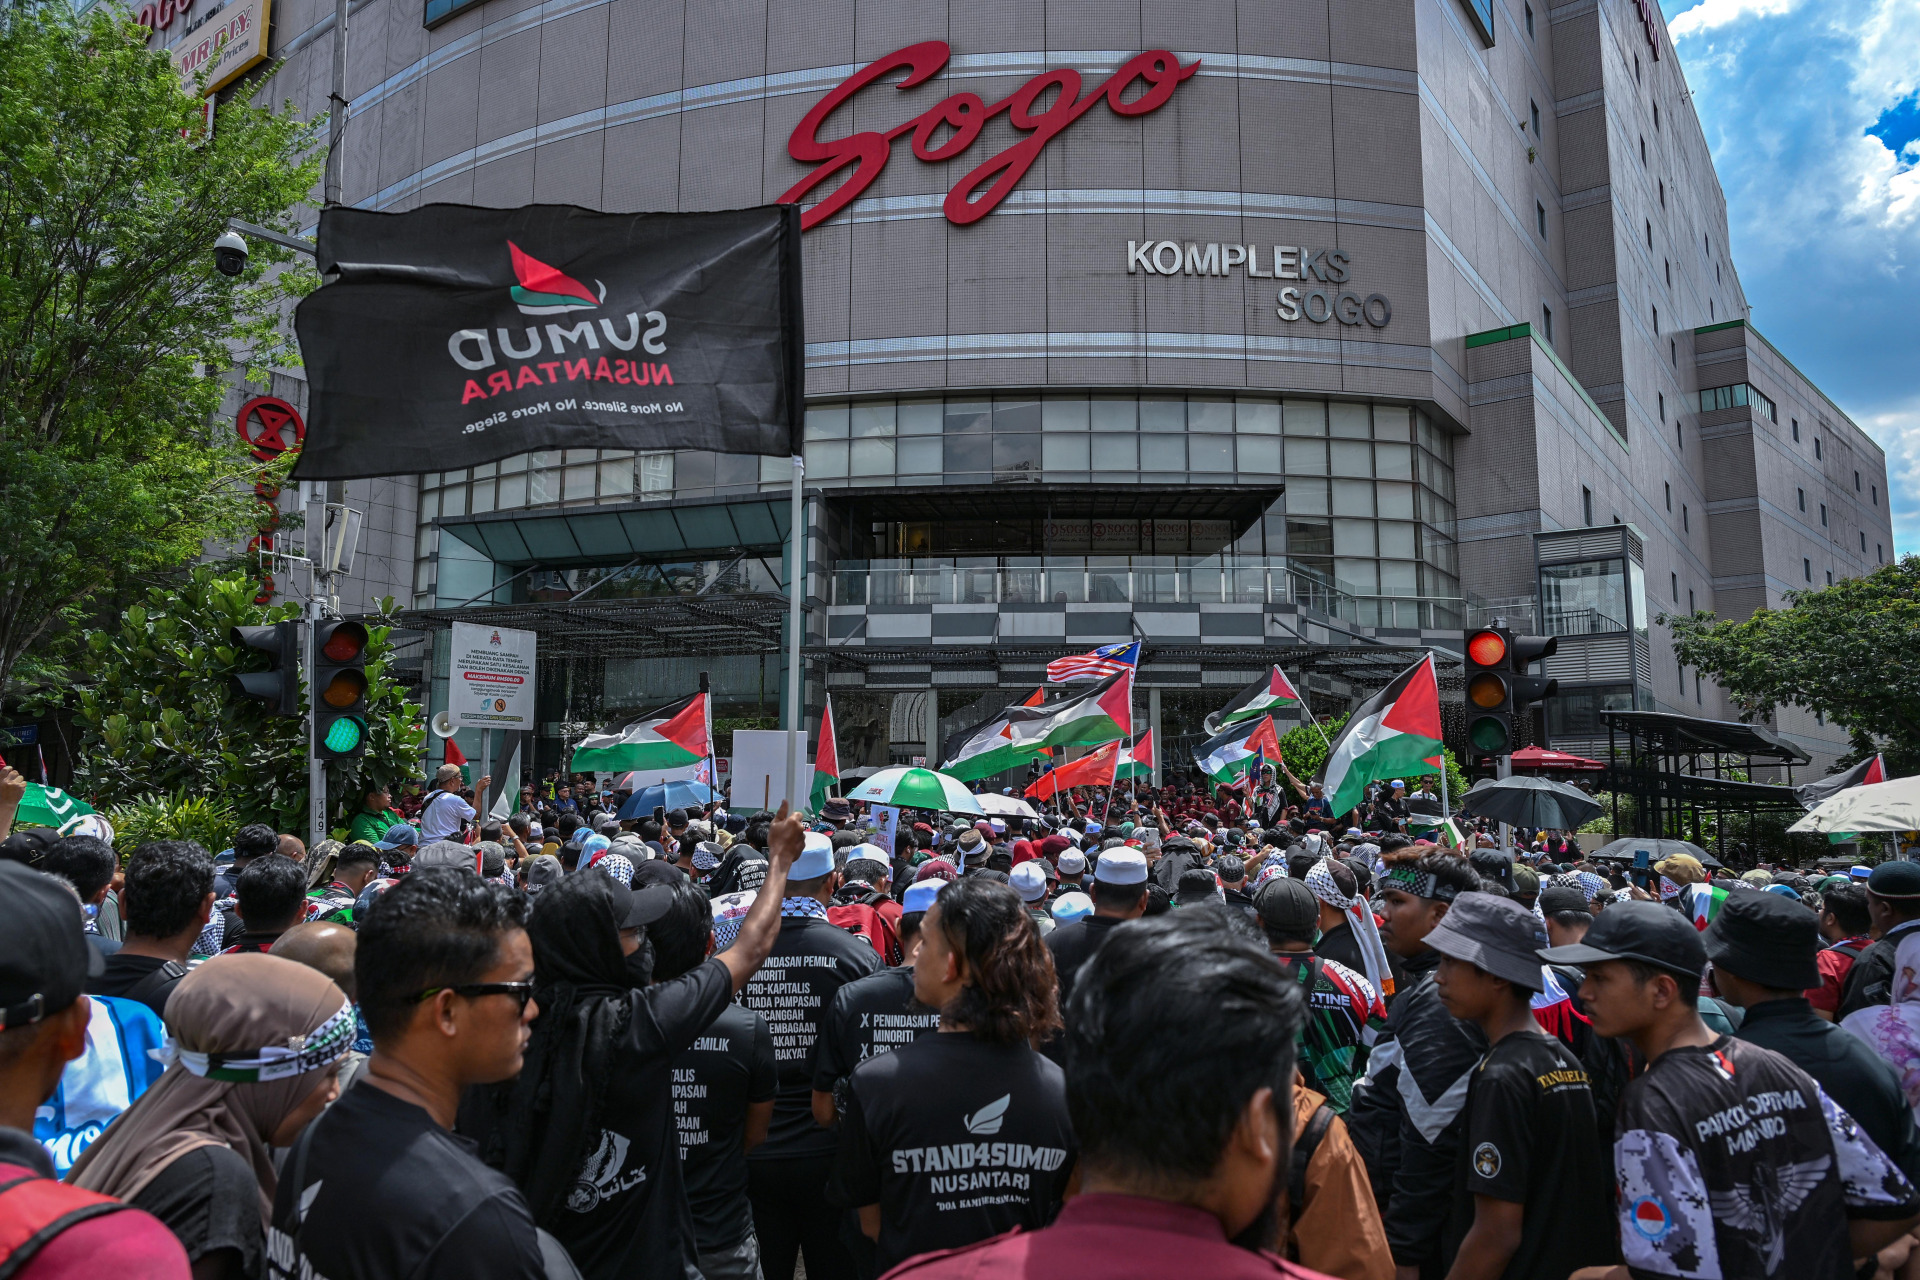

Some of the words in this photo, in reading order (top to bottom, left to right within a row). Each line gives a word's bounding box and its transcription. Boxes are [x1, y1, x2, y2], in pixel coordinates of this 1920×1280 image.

[181, 39, 209, 75] MR
[224, 39, 249, 63] Prices
[776, 40, 1201, 231] Sogo
[1127, 240, 1350, 284] KOMPLEKS
[1276, 286, 1392, 328] SOGO
[1060, 524, 1090, 534] SOGO
[1108, 524, 1138, 533] SOGO
[1156, 523, 1187, 533] SOGO
[804, 956, 837, 968] PEMILIK
[747, 982, 810, 995] PRO-KAPITALIS
[747, 997, 772, 1008] TIADA
[774, 996, 820, 1008] PAMPASAN
[874, 1014, 929, 1028] PENINDASAN
[874, 1030, 913, 1042] MINORITI
[688, 1037, 730, 1052] EMILIK
[775, 1048, 807, 1060] RAKYAT
[672, 1085, 707, 1098] PASAN
[679, 1130, 708, 1145] TANAH
[892, 1142, 1066, 1173] STAND4SUMUD
